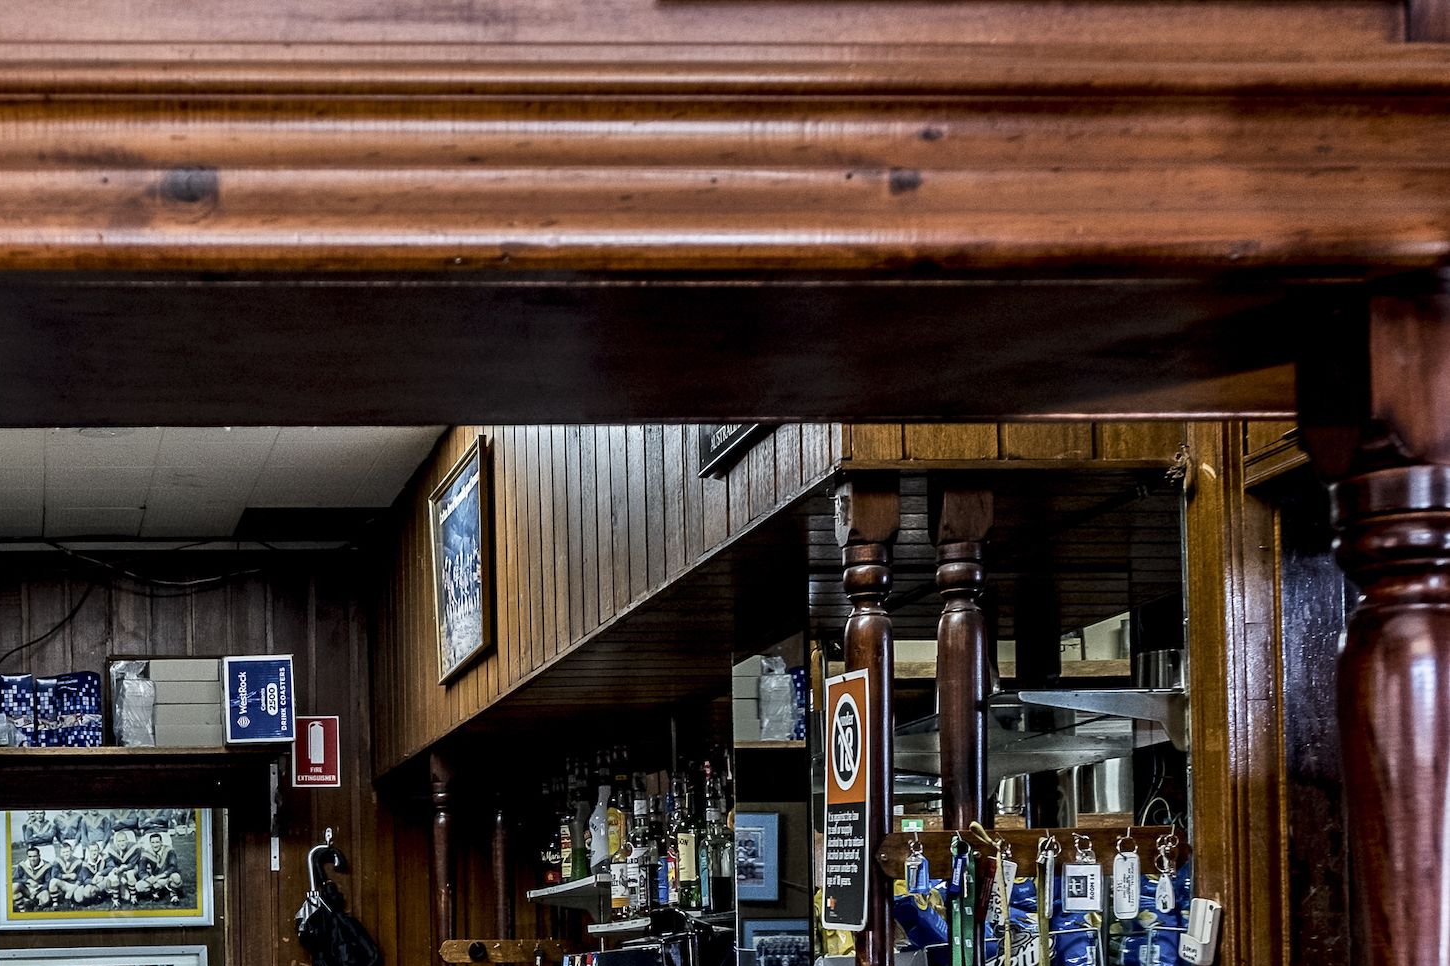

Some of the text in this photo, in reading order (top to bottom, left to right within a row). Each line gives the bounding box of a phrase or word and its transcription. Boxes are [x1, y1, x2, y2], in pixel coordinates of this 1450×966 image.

[237, 671, 248, 714] WestRock
[268, 687, 276, 711] 2500
[278, 666, 288, 731] DRINK COASTERS
[297, 774, 336, 782] EXTINGUISHER
